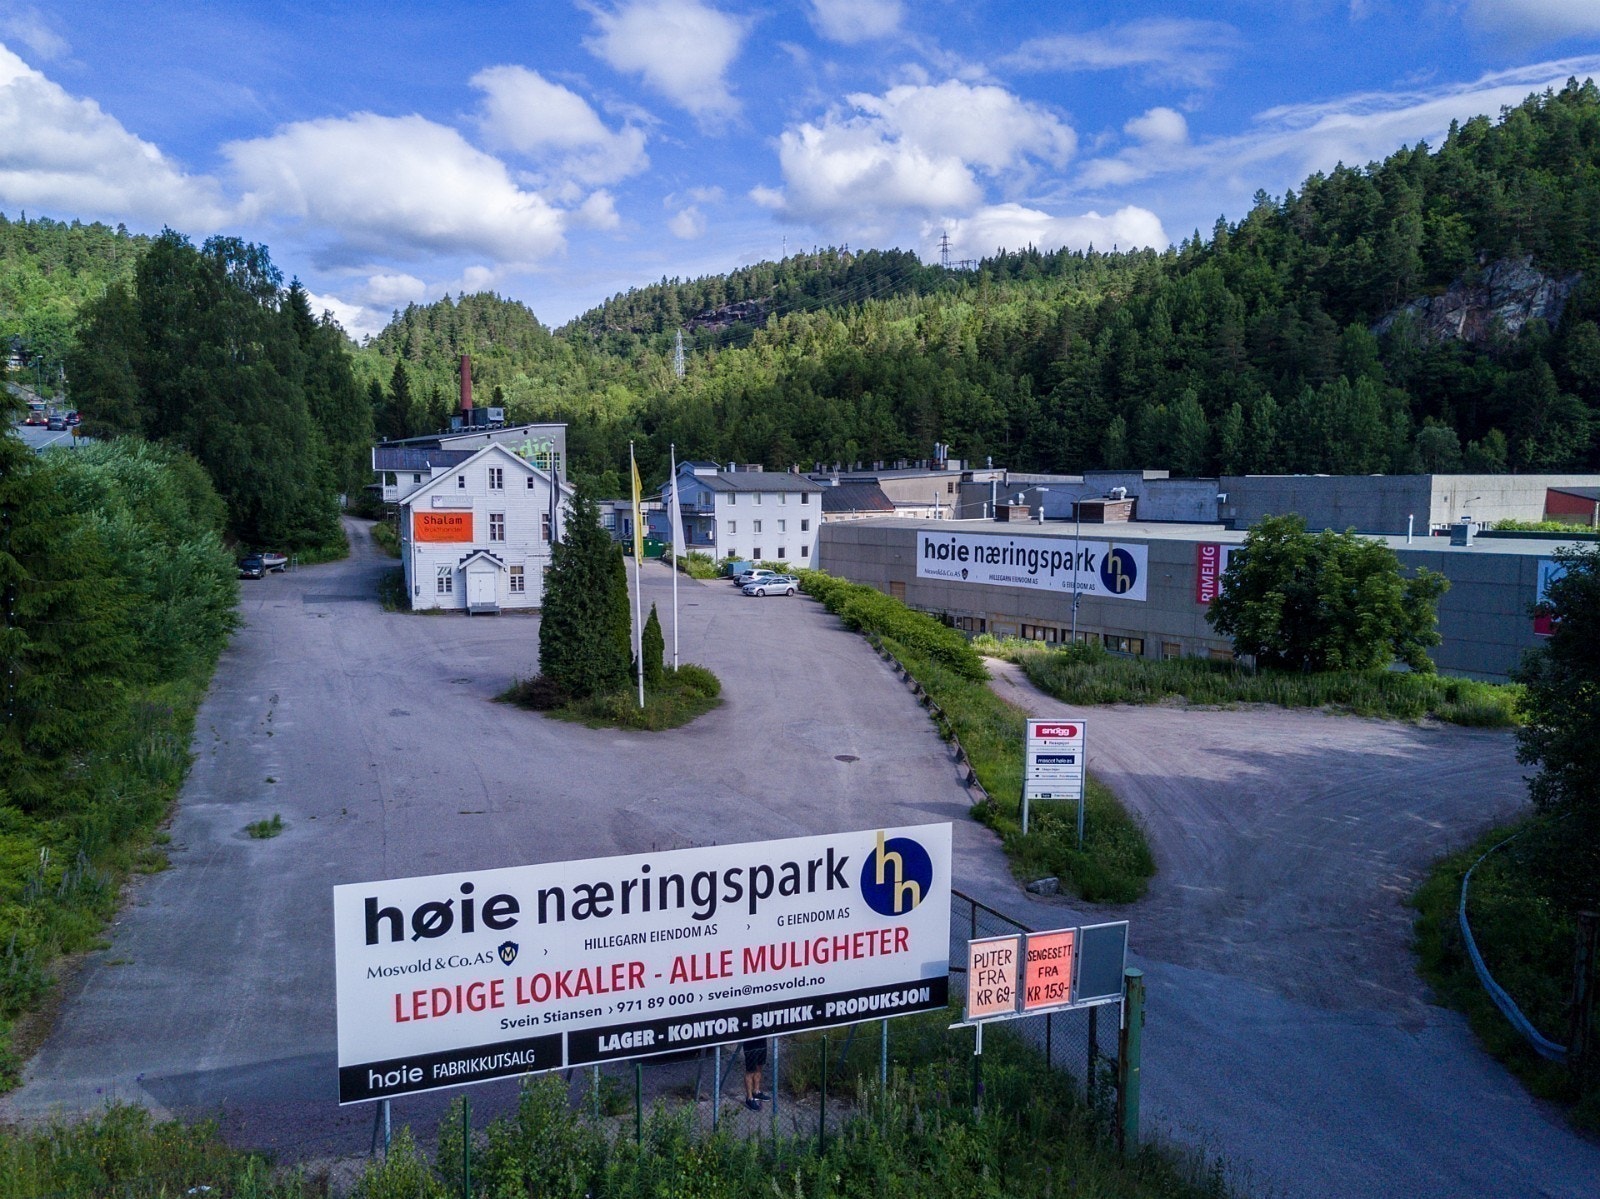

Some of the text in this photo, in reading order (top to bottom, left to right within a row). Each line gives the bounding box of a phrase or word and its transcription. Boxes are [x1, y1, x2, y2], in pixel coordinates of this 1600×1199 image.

[424, 516, 462, 525] Shalam
[924, 538, 1096, 577] høie næringspark
[364, 847, 849, 946] høie næringspark
[777, 907, 850, 927] G EIENDOM AS
[584, 923, 718, 950] HILLEGARN EIENDOM AS
[974, 949, 1012, 969] PUTER
[1027, 944, 1073, 962] SENGESETT
[367, 951, 494, 979] Mosvold & Co. AS
[395, 979, 504, 1023] LEDIGE
[516, 961, 645, 1005] LOKALER
[670, 950, 733, 985] ALLE
[743, 926, 910, 975] MULIGHETER
[1038, 966, 1058, 978] FRA
[978, 969, 1006, 987] FRA
[500, 975, 826, 1030] Svein Stiansen 971 89 000 svein@mosvold.no
[976, 988, 993, 1006] KR
[1027, 987, 1041, 1002] KR
[598, 1029, 655, 1052] LAGER
[668, 1017, 740, 1042] KONTOR
[752, 1005, 813, 1029] BUTIKK
[826, 987, 930, 1018] PRODUKSJON
[368, 1049, 536, 1089] høie FABRIKKUTSALG
